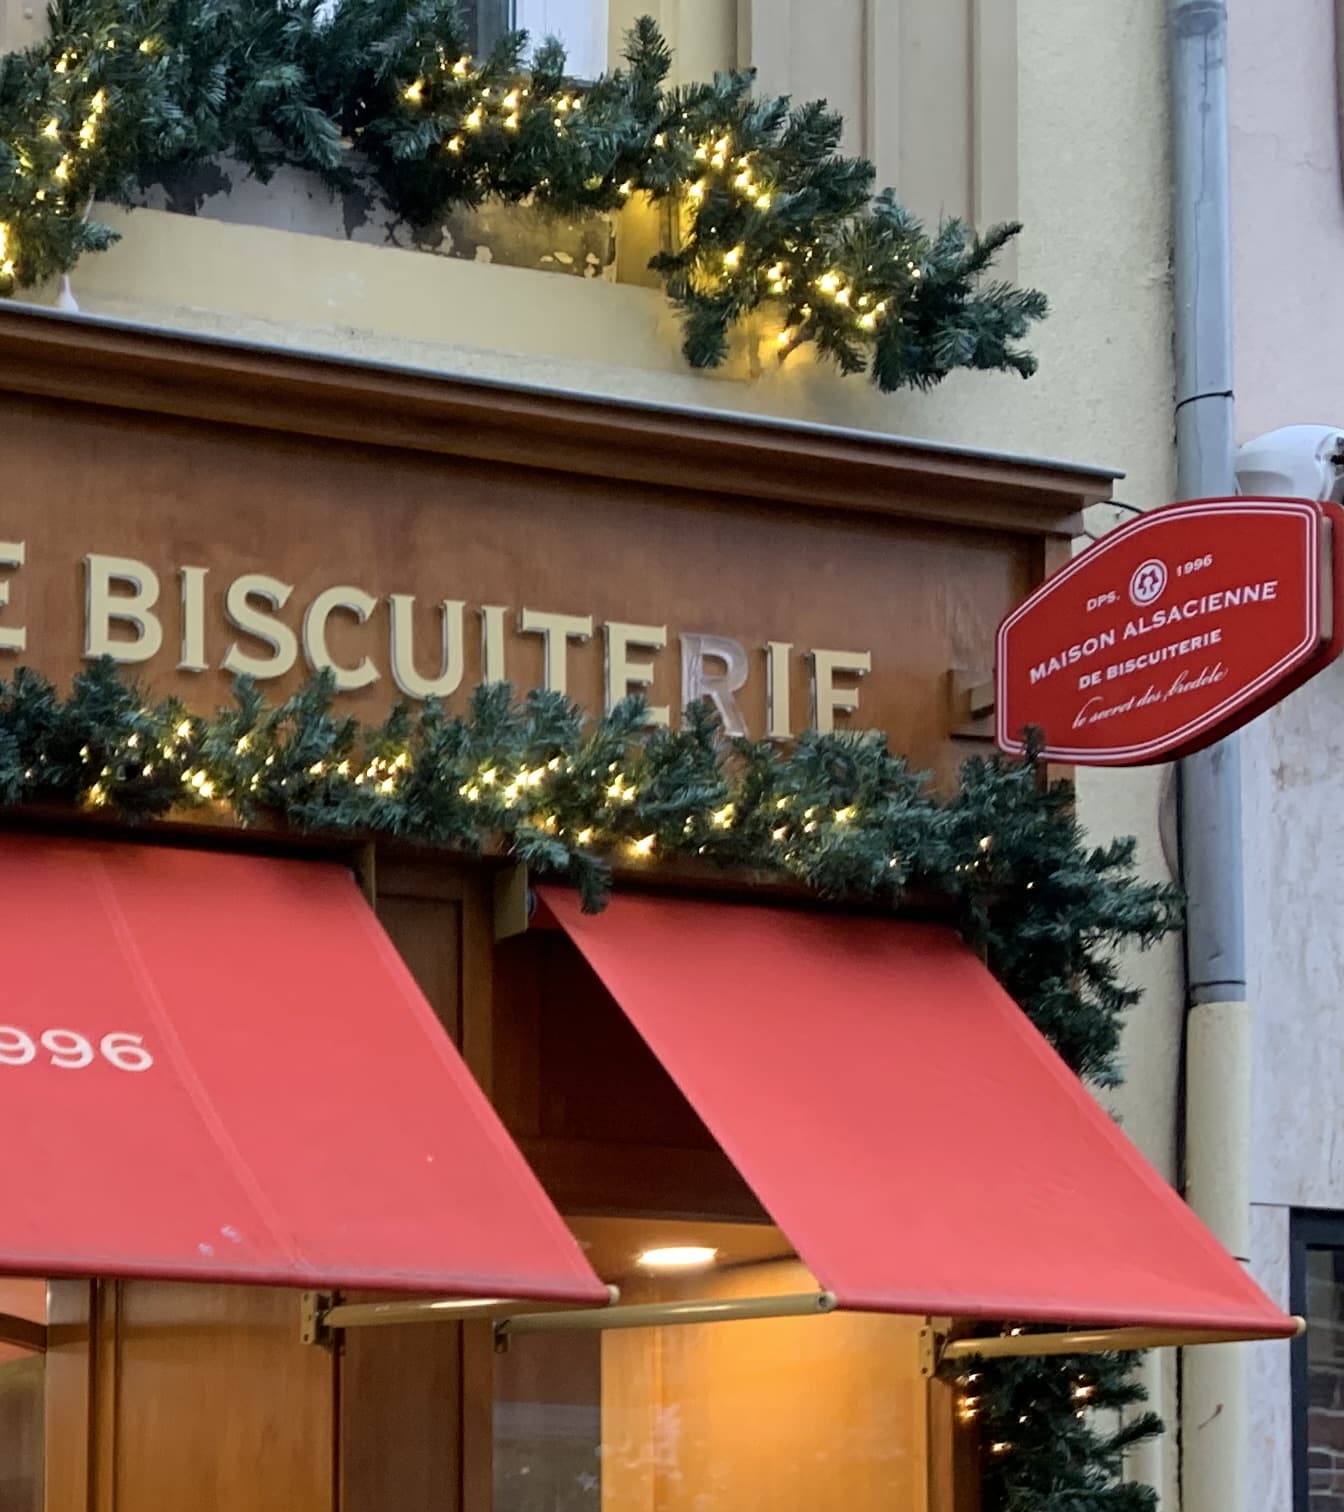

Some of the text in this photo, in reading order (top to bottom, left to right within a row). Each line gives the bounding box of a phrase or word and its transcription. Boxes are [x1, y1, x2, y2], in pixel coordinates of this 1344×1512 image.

[1086, 553, 1214, 612] DPS. 1996
[83, 552, 872, 744] BISCUITERIE
[1028, 580, 1279, 685] MAISON ALSACIENNE
[1078, 628, 1223, 690] DE BISCUITERIE
